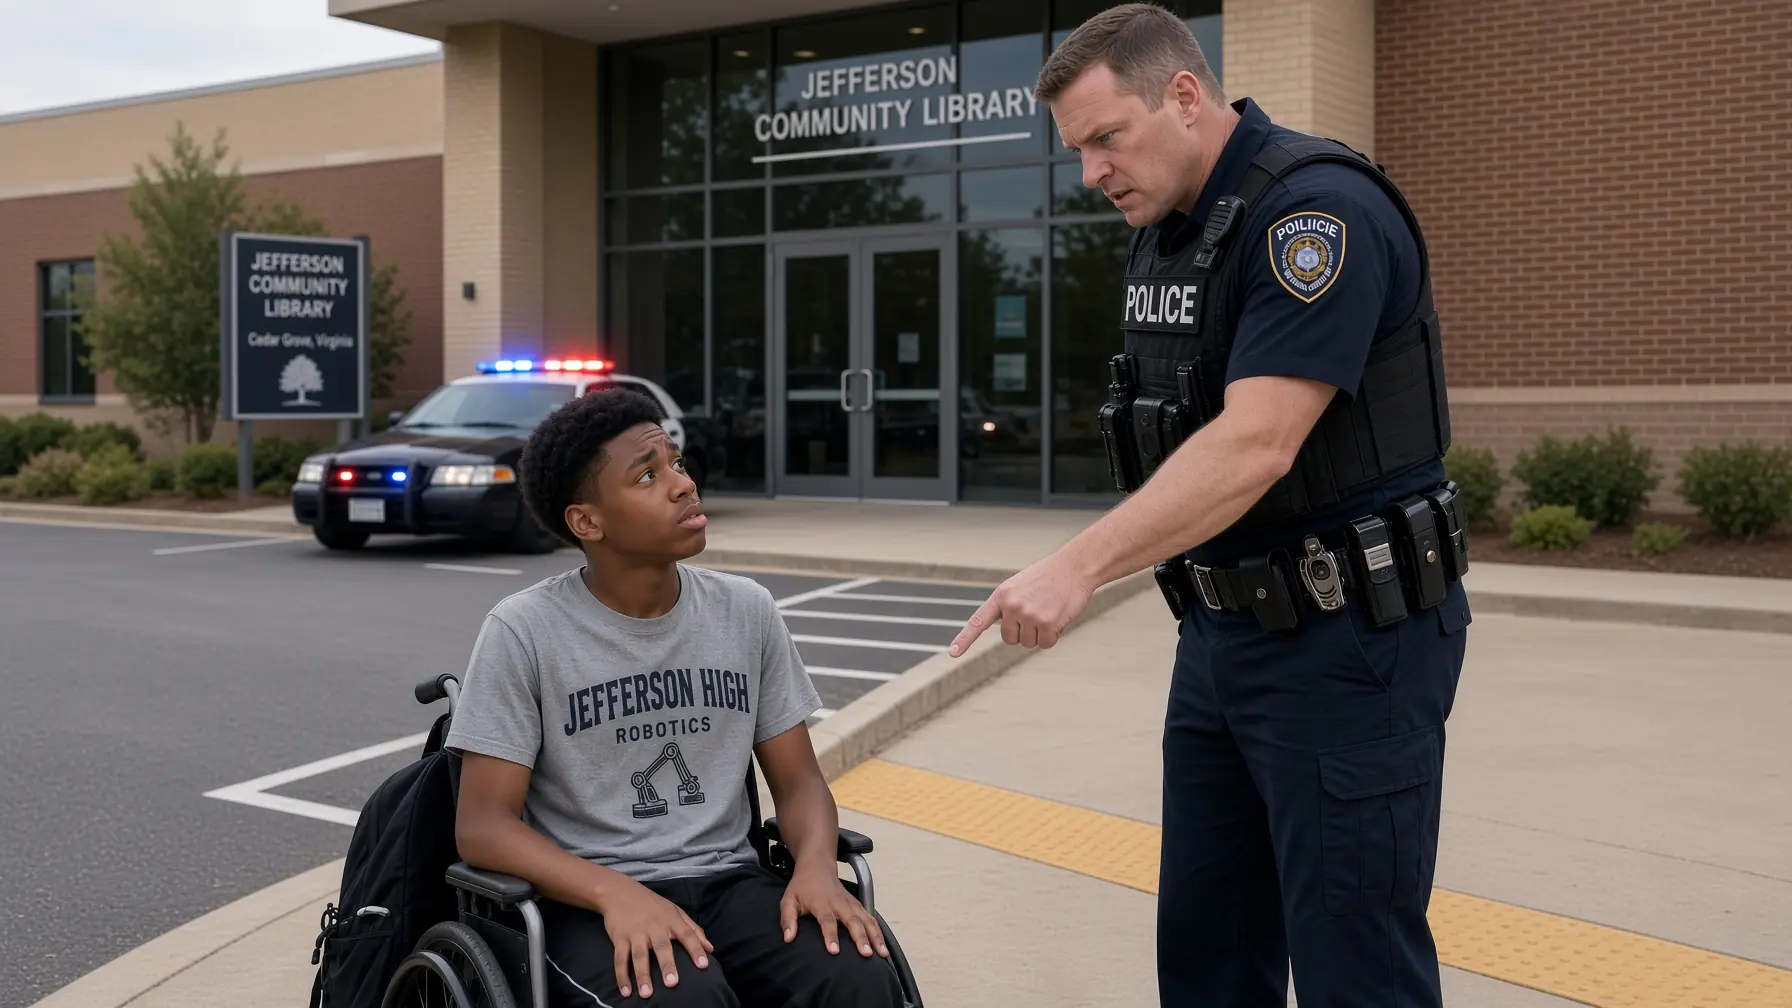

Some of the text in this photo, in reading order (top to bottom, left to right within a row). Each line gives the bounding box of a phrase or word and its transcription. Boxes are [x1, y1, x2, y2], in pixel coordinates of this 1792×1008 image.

[801, 55, 956, 100] JEFFERSON
[754, 86, 1039, 143] COMMUNITY LIBRARY
[251, 251, 344, 274] JEFFERSON
[248, 274, 348, 297] COMMUNITY
[264, 298, 334, 319] LIBRARY
[1124, 284, 1197, 324] POLICE
[247, 331, 280, 348] Cedar
[564, 668, 751, 737] JEFFERSON HIGH
[616, 716, 711, 744] ROBOTICS
